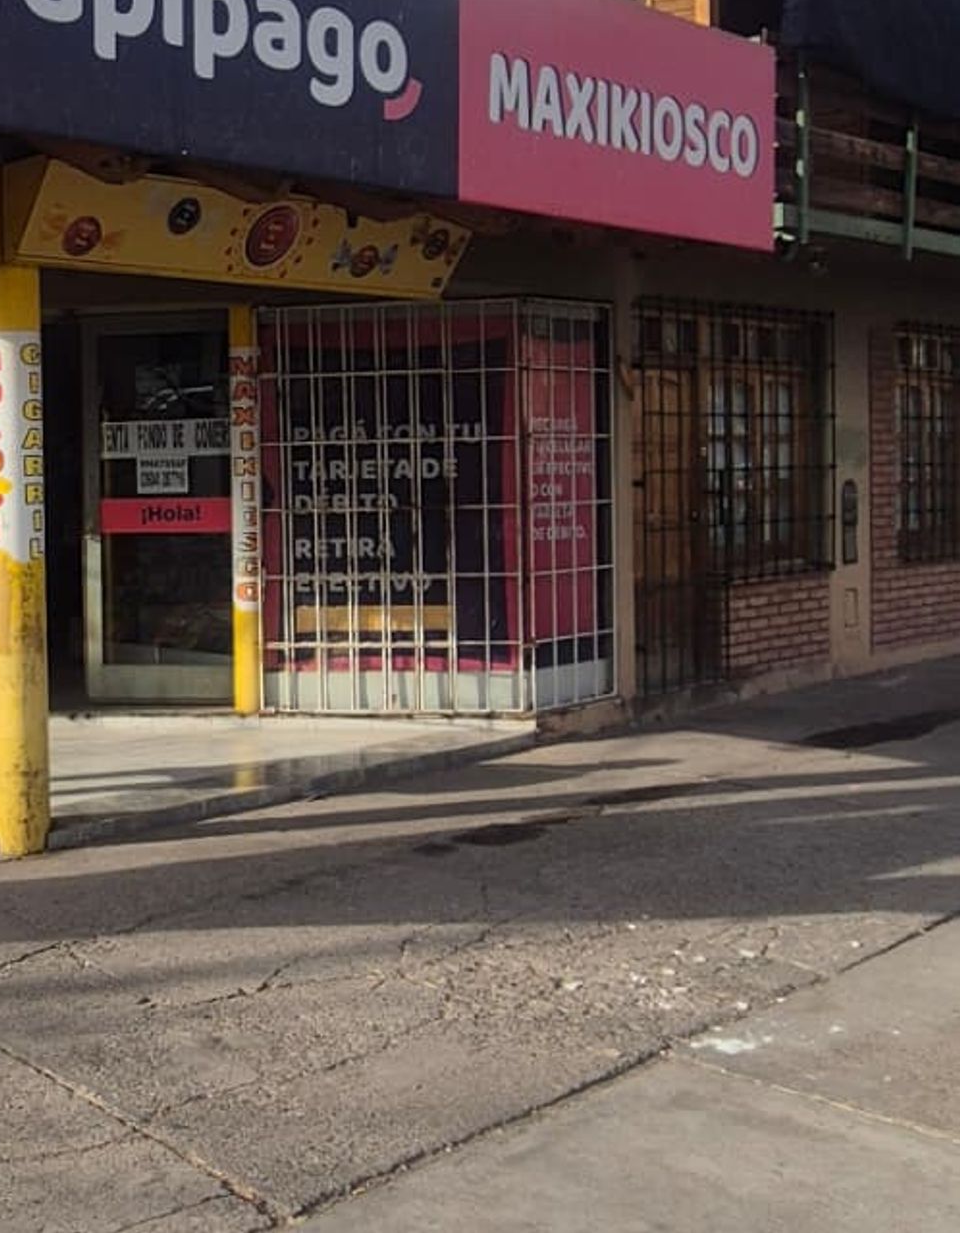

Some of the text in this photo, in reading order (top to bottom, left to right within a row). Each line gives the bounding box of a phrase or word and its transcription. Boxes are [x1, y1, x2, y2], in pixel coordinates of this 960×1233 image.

[489, 52, 759, 178] MAXIKIOSCO
[141, 504, 201, 525] ¡Hola!
[294, 484, 399, 515] DÉBTO
